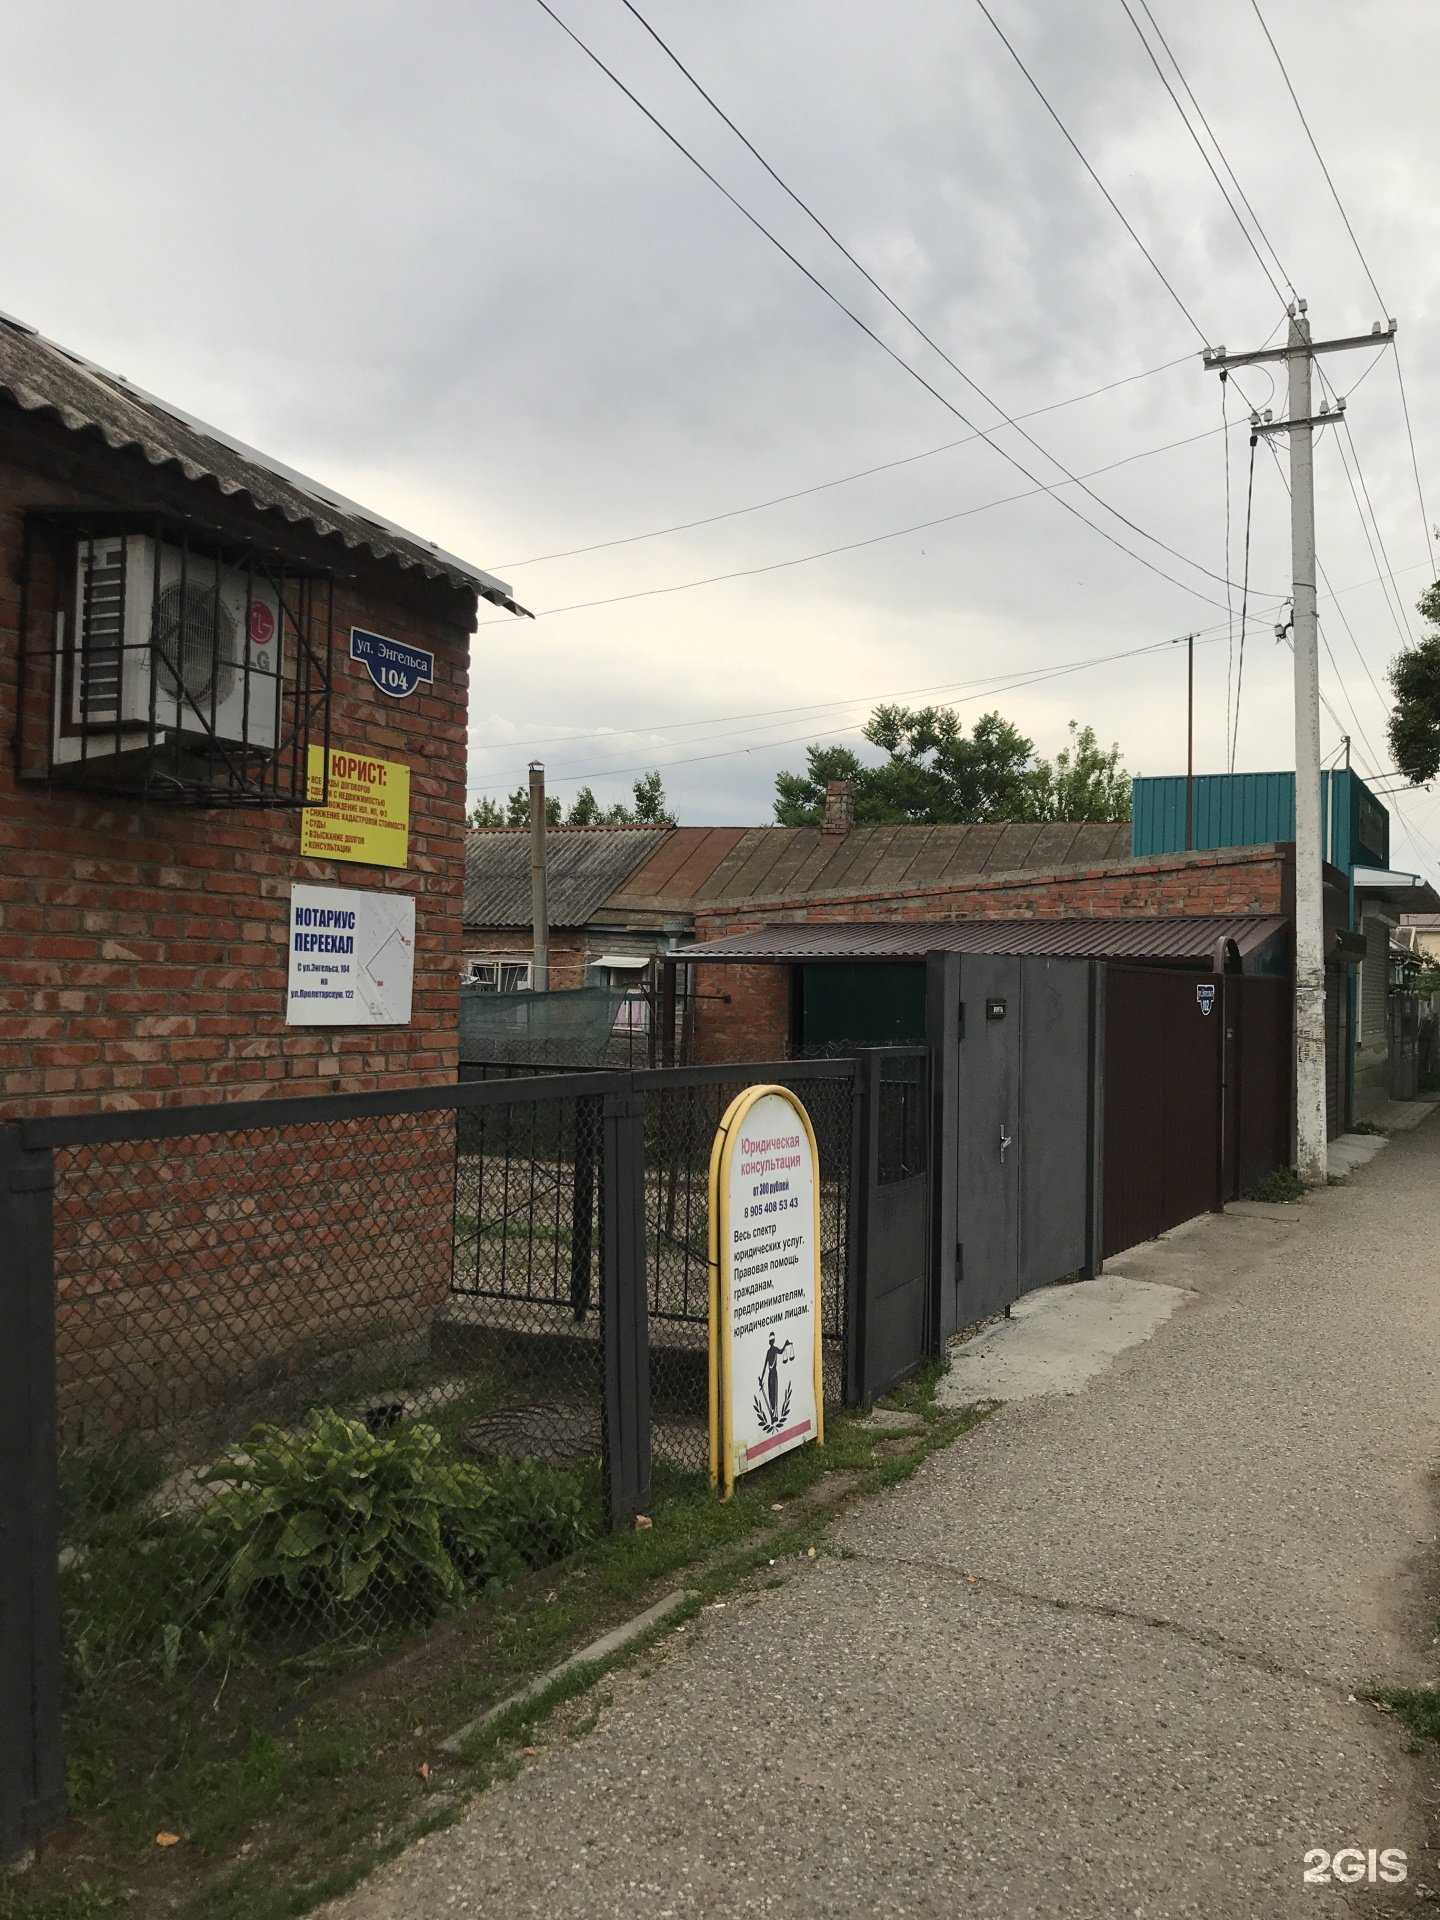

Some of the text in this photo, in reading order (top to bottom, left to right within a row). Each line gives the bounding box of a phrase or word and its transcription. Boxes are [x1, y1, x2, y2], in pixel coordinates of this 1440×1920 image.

[357, 639, 427, 671] ул. Энгельса
[380, 667, 408, 690] 104
[332, 755, 386, 786] ЮРИСТ:
[310, 808, 340, 819] СНИЖЕНИЕ
[310, 819, 326, 829] СУДЫ
[296, 907, 355, 929] НОТАРИУС
[294, 933, 353, 954] ПЕРЕЕХАЛ
[341, 965, 349, 973] 104
[742, 1136, 799, 1157] Юридическая
[741, 1155, 800, 1176] консультация
[753, 1187, 759, 1196] от
[770, 1180, 789, 1194] рублей
[744, 1198, 798, 1218] 8 905 408 53 43
[734, 1224, 776, 1243] Весь спектр
[734, 1236, 804, 1262] юридических услуг.
[734, 1255, 798, 1281] Правовая помощь
[734, 1280, 774, 1301] гражданам,
[734, 1288, 805, 1320] предпринимателям,
[734, 1305, 809, 1338] юридическим лицам.
